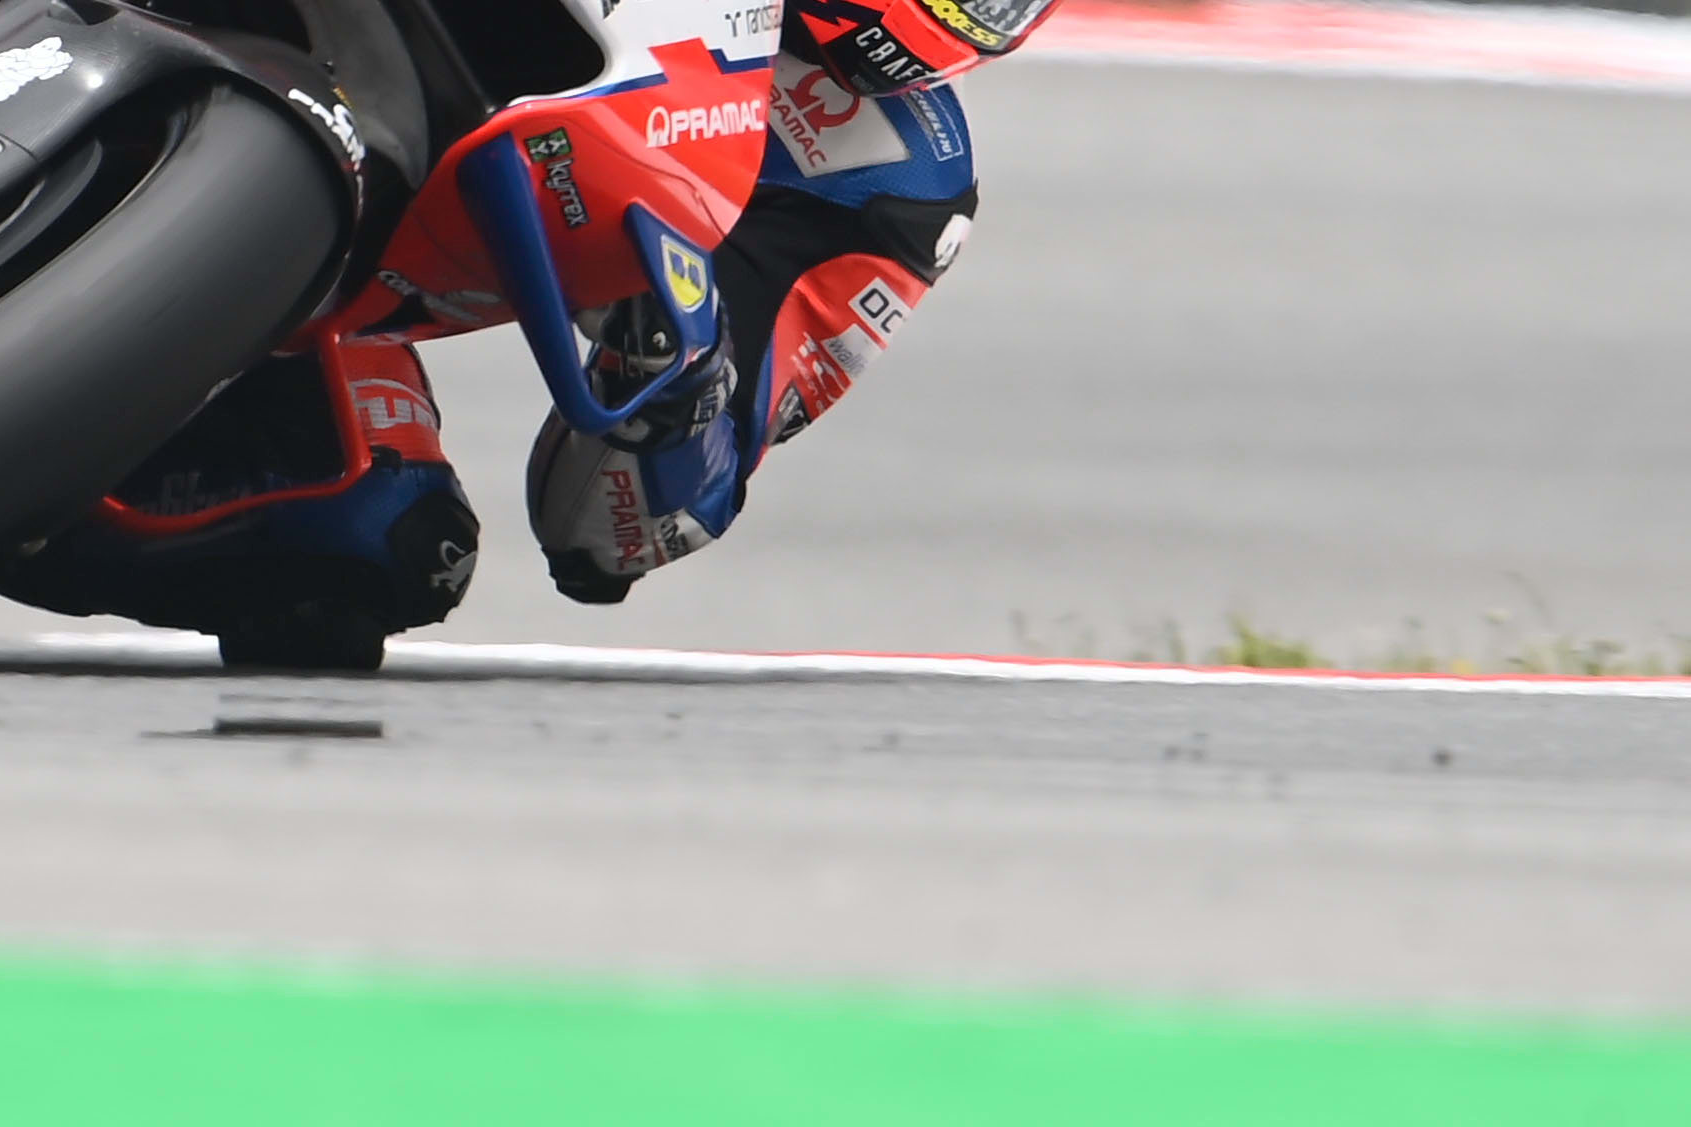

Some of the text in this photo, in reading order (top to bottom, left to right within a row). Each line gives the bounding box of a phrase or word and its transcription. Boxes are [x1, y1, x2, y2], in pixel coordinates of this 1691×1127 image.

[855, 26, 932, 81] CRAF
[670, 100, 766, 144] PRAMAC
[602, 469, 646, 571] PRAMAC
